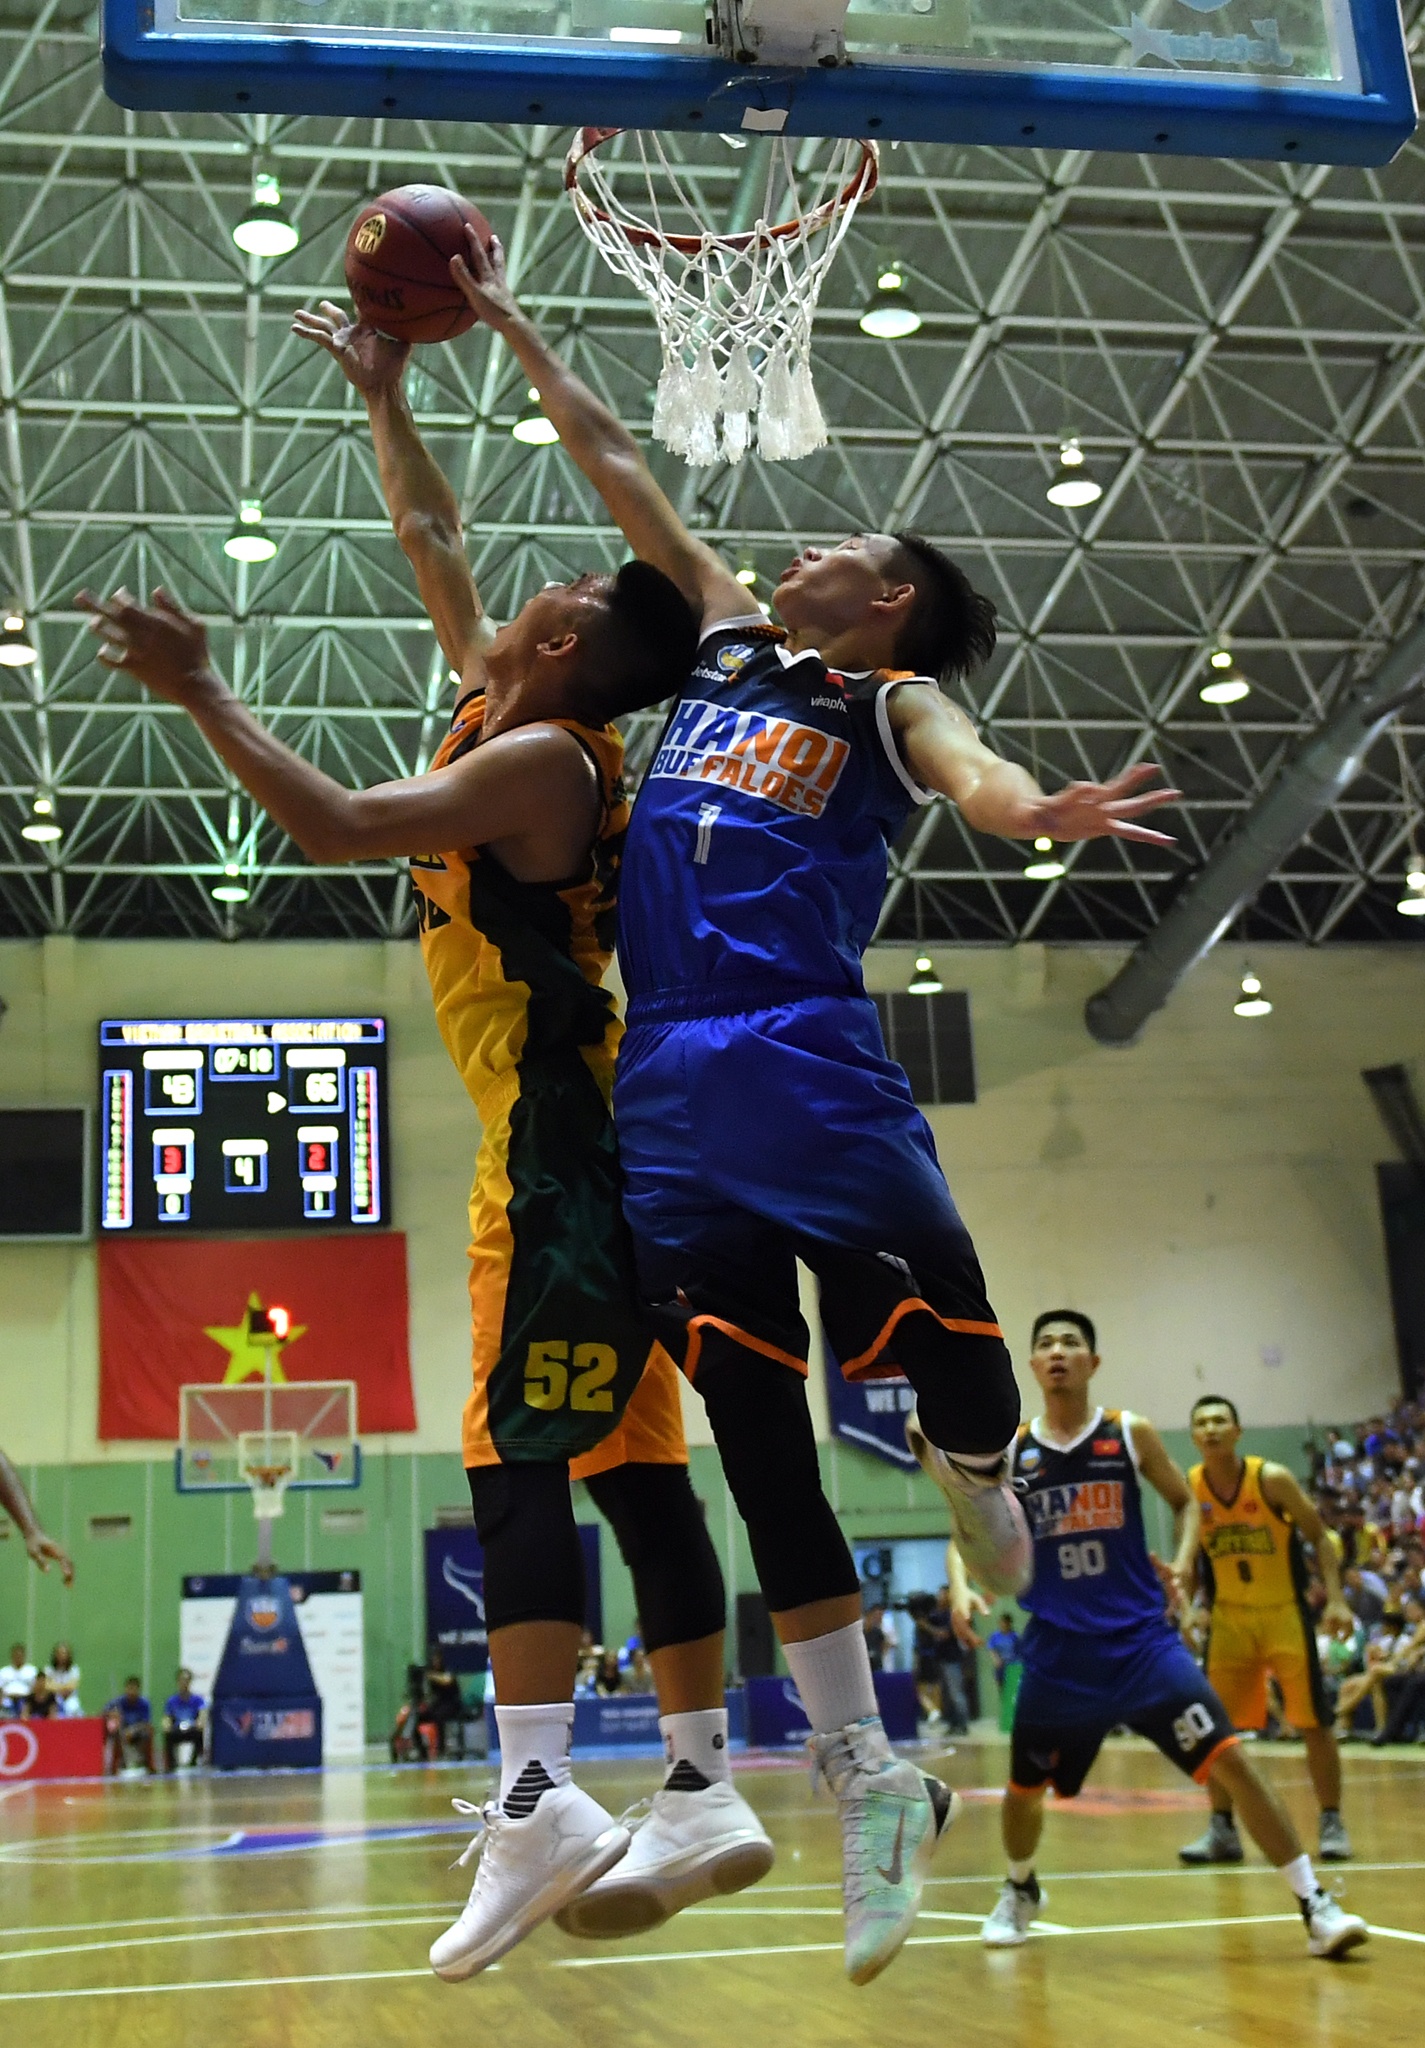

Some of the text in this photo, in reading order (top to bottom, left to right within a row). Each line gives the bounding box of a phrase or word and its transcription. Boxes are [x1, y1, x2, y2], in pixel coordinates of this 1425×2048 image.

[663, 702, 849, 792] HANOI
[652, 748, 826, 816] BUFFALOES
[163, 1146, 182, 1173] 3
[235, 1156, 254, 1185] 4
[308, 1143, 326, 1171] 2
[524, 1341, 618, 1412] 52
[1058, 1540, 1105, 1580] 90
[1174, 1702, 1215, 1751] 90
